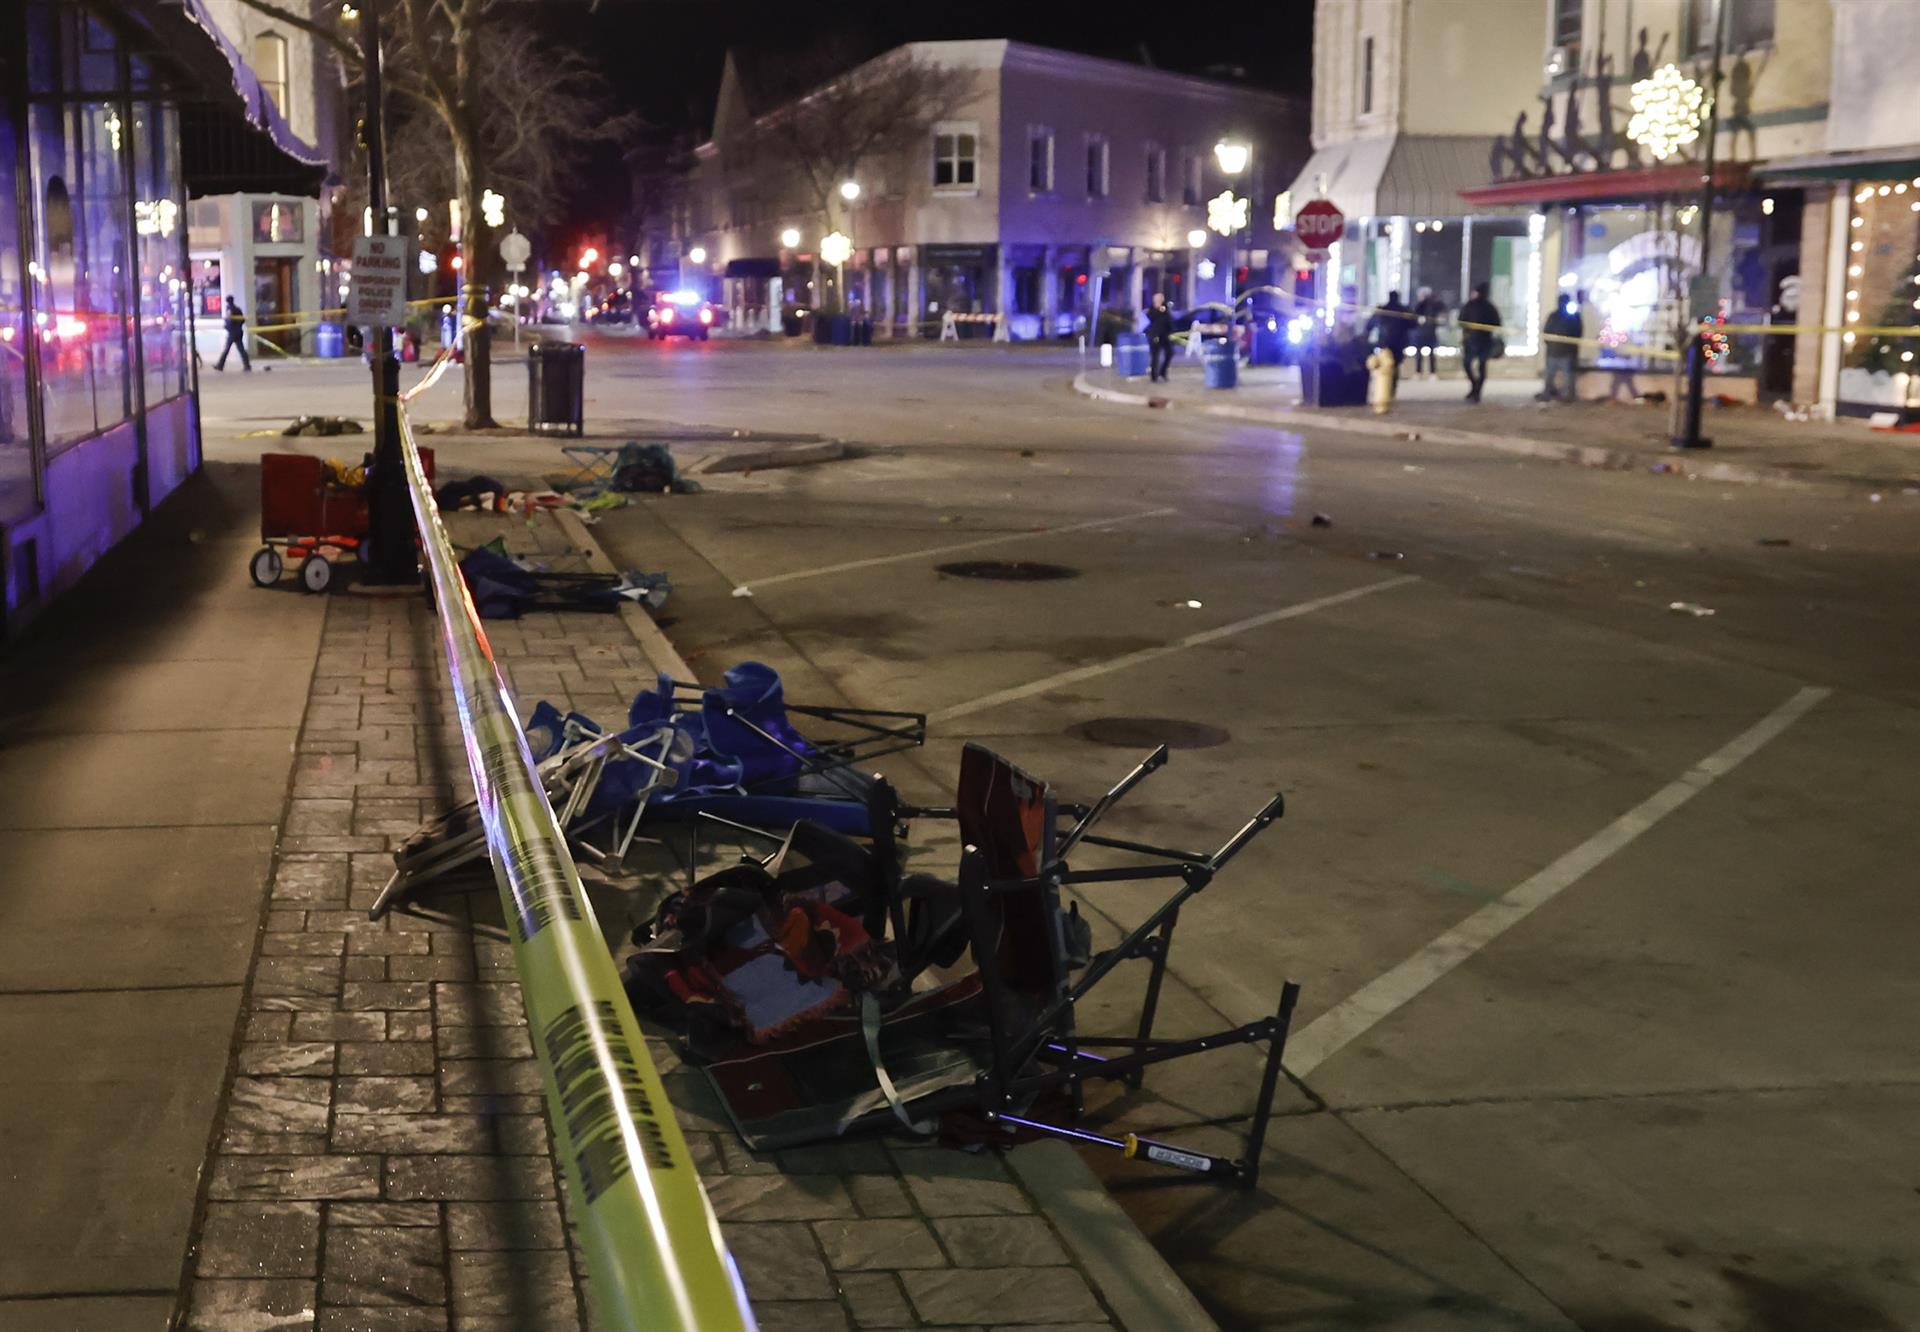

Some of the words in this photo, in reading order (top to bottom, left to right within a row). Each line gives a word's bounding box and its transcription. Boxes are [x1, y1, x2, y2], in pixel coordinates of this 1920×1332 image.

[1297, 214, 1343, 235] STOP
[370, 242, 385, 254] NO
[356, 256, 401, 269] PARKING
[358, 287, 393, 297] POLICE
